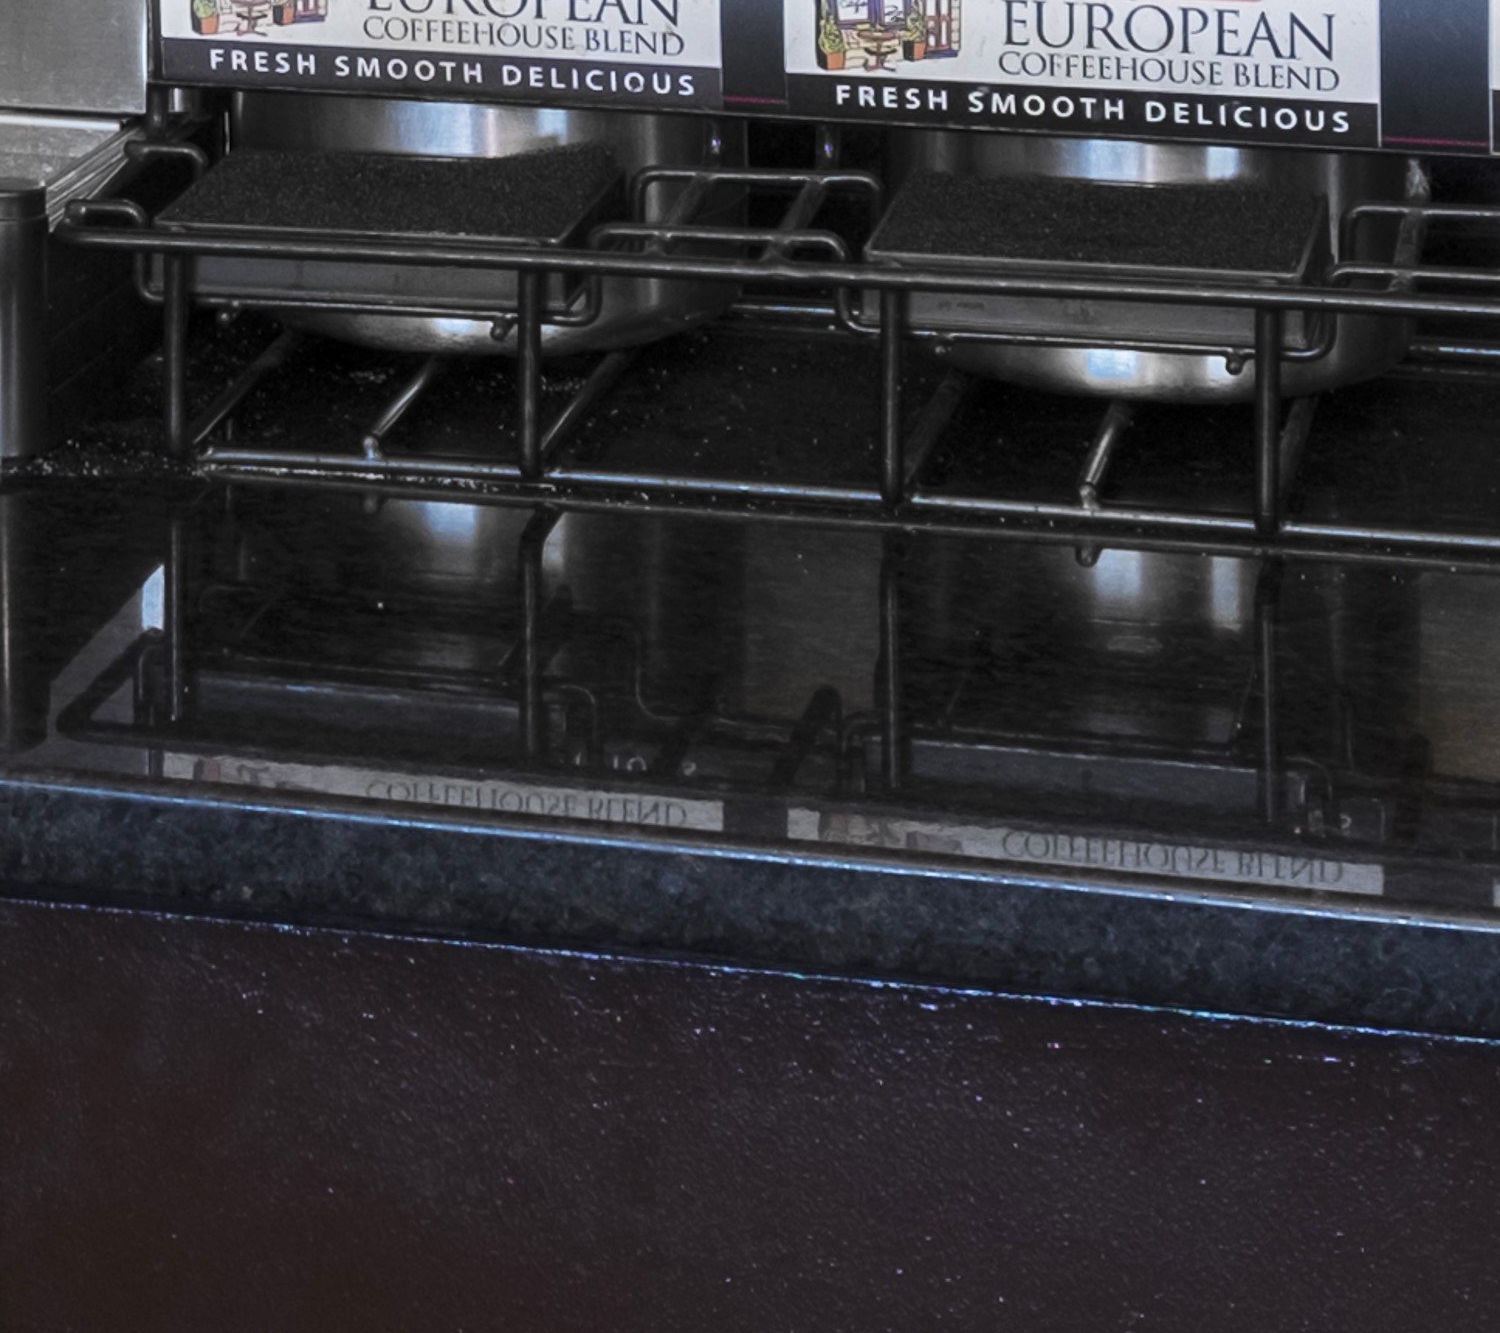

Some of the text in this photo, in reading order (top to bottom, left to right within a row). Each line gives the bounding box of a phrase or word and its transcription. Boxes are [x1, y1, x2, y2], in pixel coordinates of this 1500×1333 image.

[363, 16, 685, 57] COFFEEHOUSE BLEND
[209, 49, 695, 96] FRESH SMOOTH DELICIOUS
[998, 51, 1340, 92] COFFEEHOUSE BLEND
[836, 84, 1349, 133] FRESH SMOOTH DELICIOUS
